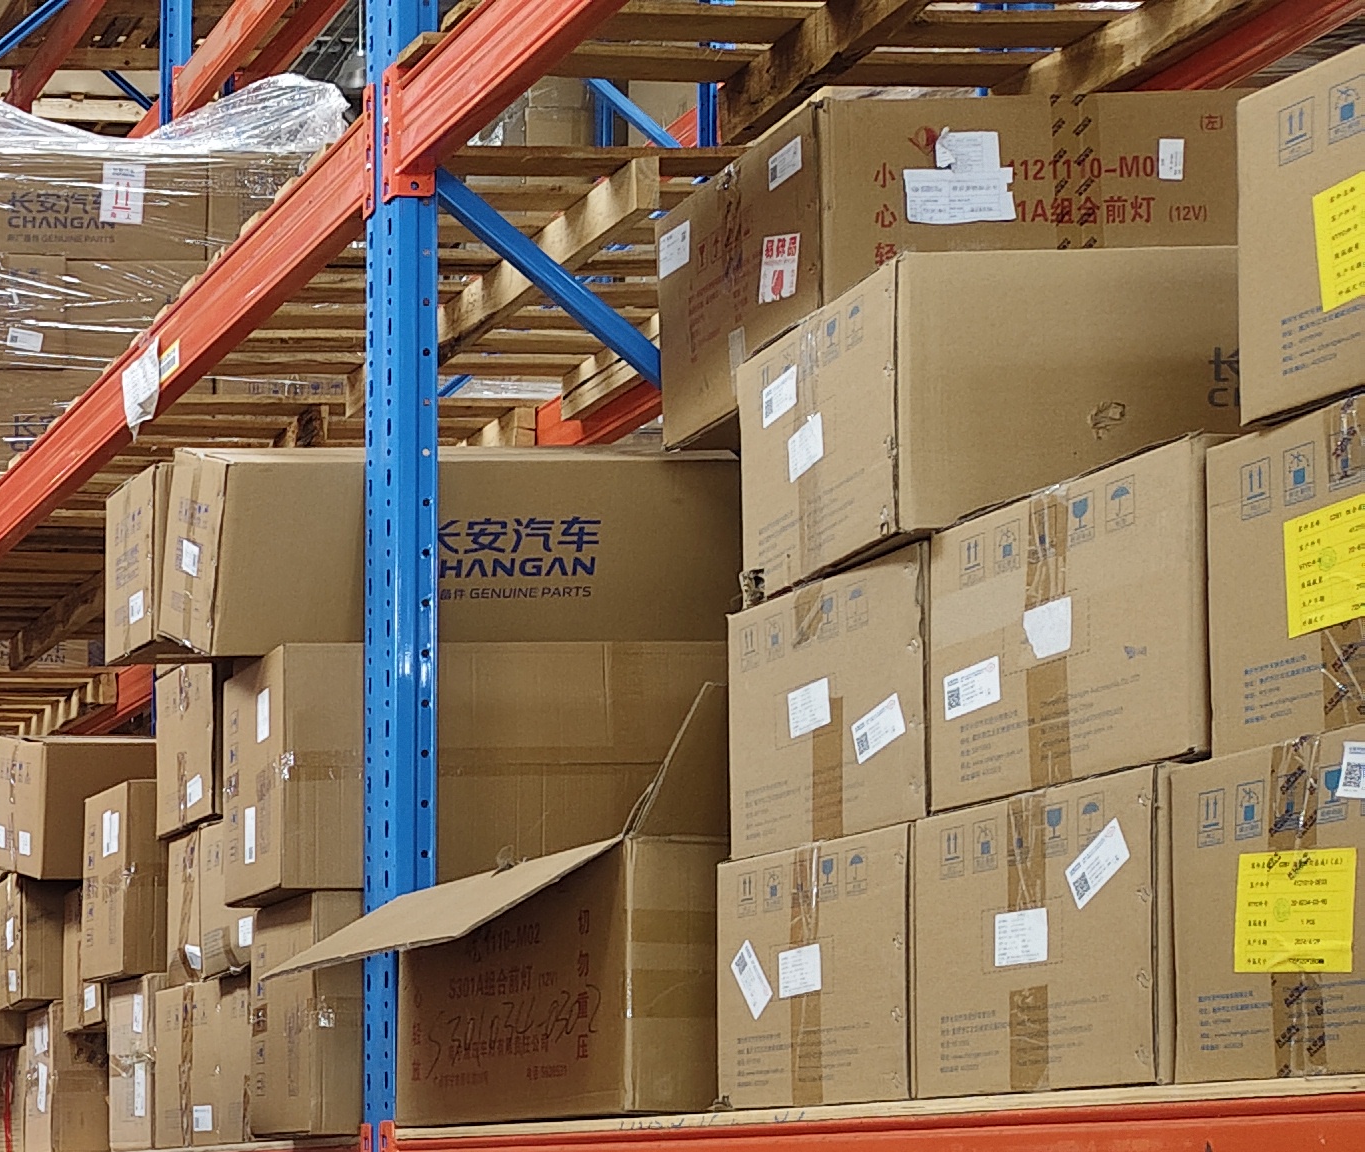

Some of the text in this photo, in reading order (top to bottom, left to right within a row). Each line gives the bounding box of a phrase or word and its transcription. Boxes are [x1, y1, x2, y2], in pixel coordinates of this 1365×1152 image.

[1007, 154, 1156, 182] 121110-M0
[1016, 196, 1157, 225] 1A组合前灯
[1169, 204, 1208, 222] (12V)
[84, 233, 116, 244] PARTS
[439, 555, 597, 579] HANGAN
[469, 587, 539, 599] GENUINE
[541, 585, 592, 598] PARTS
